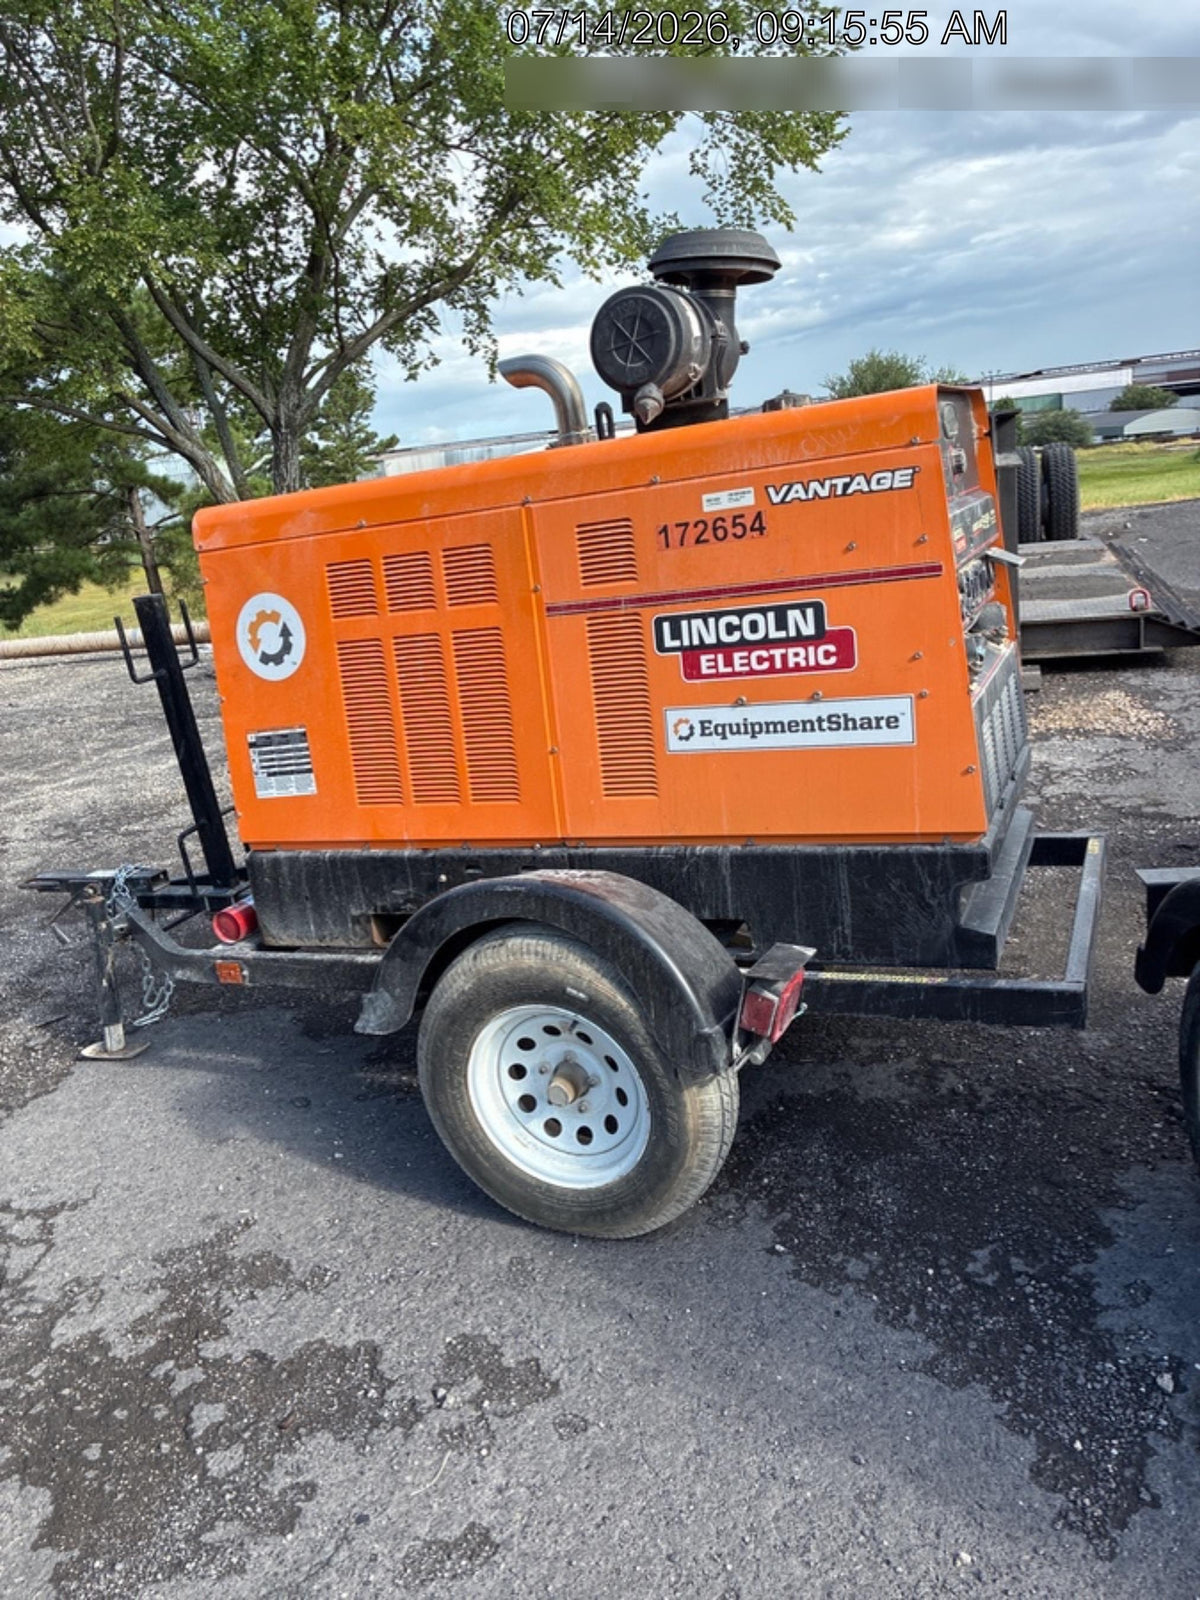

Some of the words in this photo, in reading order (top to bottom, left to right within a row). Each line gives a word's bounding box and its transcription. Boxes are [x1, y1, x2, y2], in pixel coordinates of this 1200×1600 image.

[766, 467, 917, 505] VANTAGE
[657, 510, 767, 549] 172654
[662, 607, 816, 649] LINCOLN
[699, 644, 838, 675] ELECTRIC
